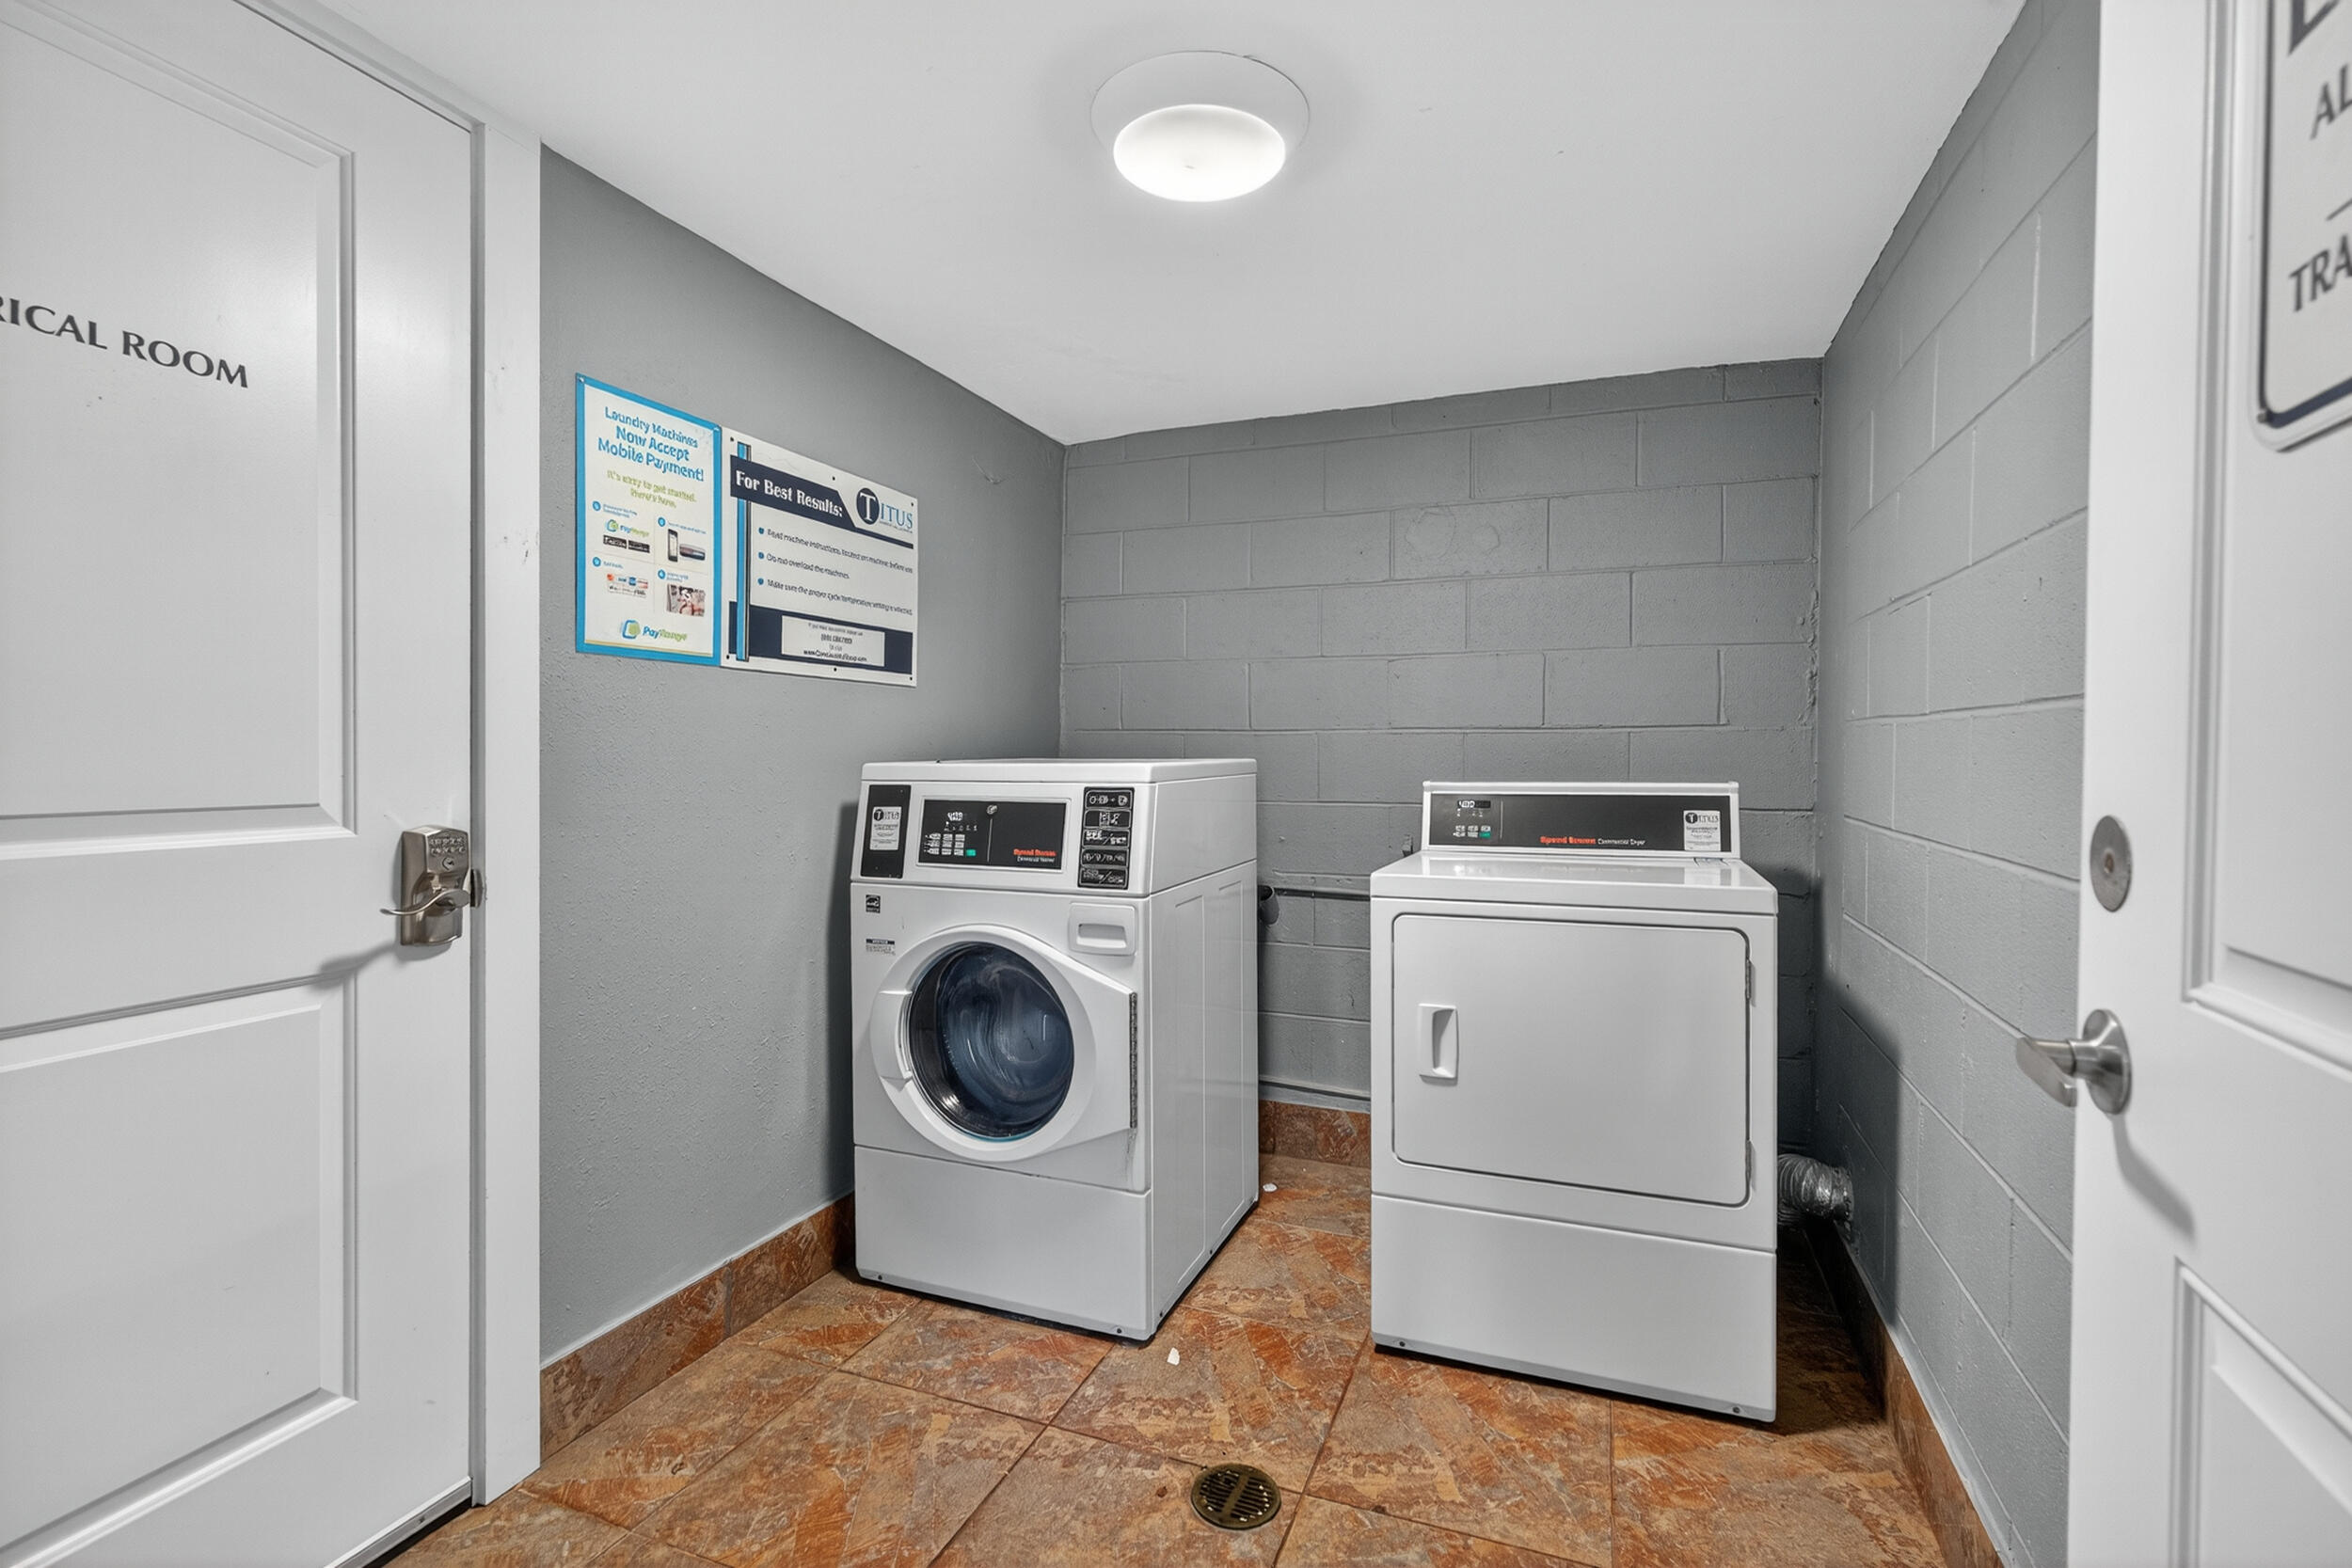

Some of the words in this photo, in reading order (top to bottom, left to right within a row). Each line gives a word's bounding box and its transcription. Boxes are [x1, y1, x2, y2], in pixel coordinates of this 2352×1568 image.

[122, 330, 247, 388] ROOM
[605, 406, 649, 434] Laundry
[652, 422, 698, 448] Machines
[616, 425, 646, 447] Now
[649, 437, 690, 461] Accept
[598, 437, 644, 463] Mobile
[646, 452, 704, 482] Payment!
[735, 470, 760, 491] For
[764, 479, 792, 501] Best
[797, 489, 843, 517] Results:
[858, 490, 913, 530] TITUS
[643, 626, 687, 641] PayRange
